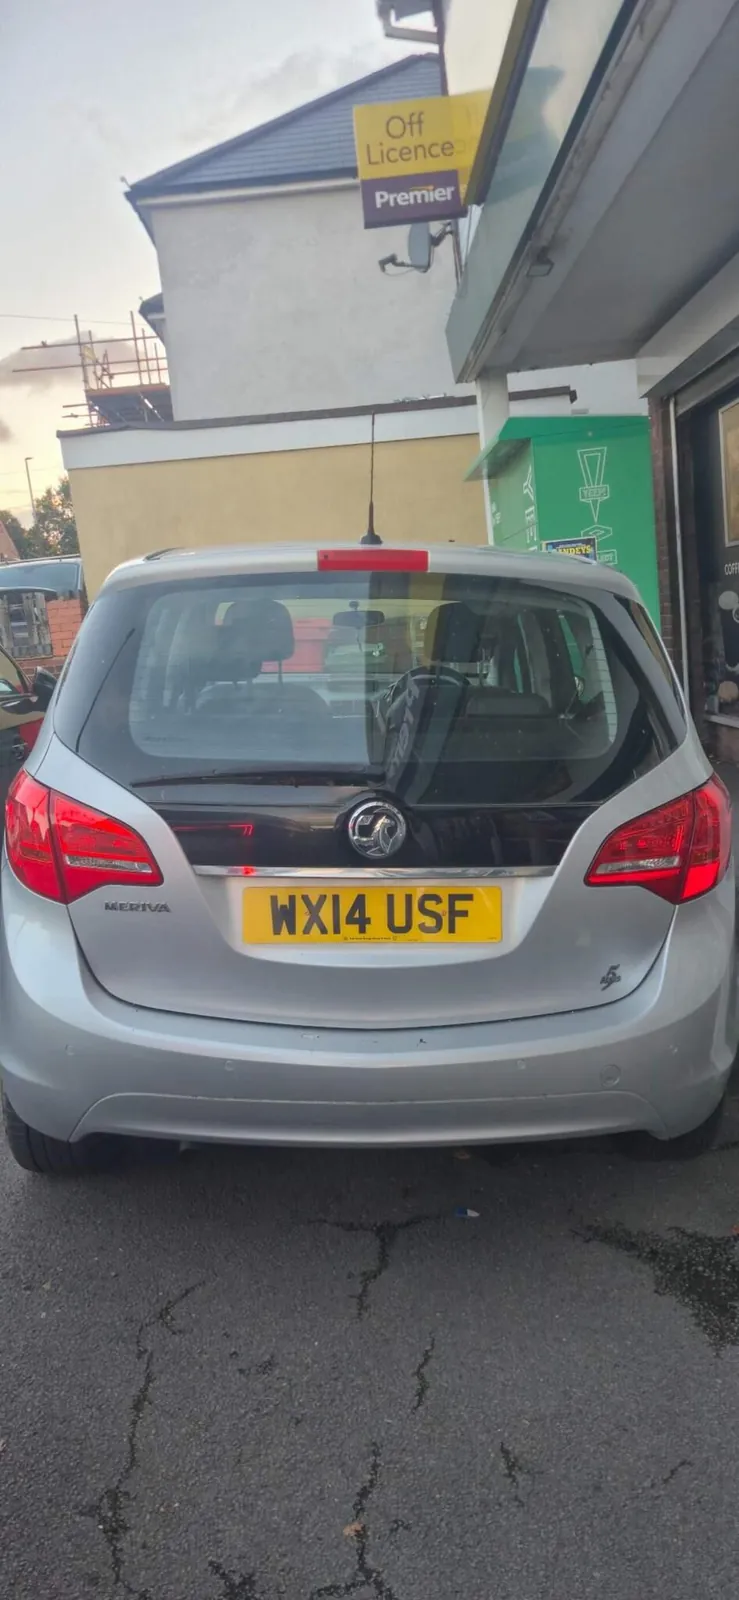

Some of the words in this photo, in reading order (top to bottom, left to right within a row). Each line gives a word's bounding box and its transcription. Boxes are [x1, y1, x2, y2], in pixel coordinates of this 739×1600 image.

[386, 111, 424, 139] Off
[366, 140, 455, 166] Licence
[375, 186, 455, 208] Premier
[104, 902, 171, 913] MERIVA
[270, 894, 371, 935] WX14
[387, 894, 474, 934] USF
